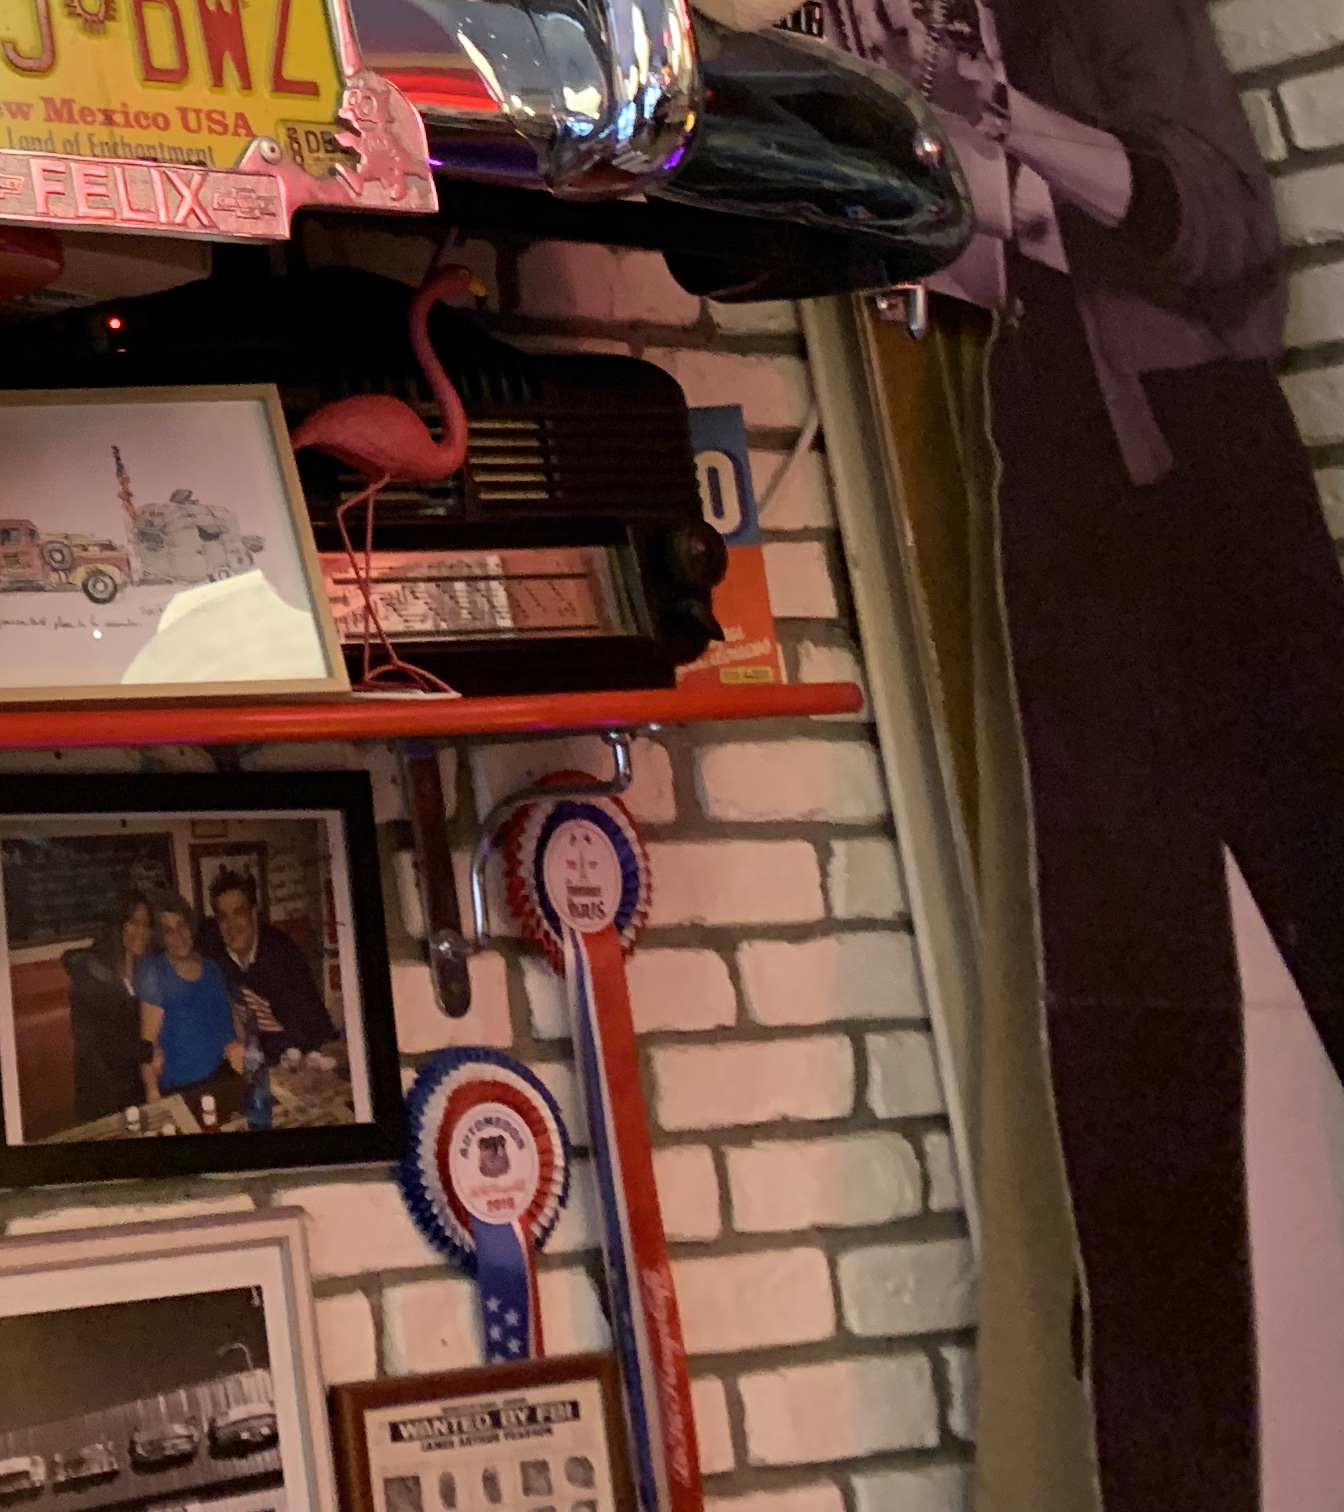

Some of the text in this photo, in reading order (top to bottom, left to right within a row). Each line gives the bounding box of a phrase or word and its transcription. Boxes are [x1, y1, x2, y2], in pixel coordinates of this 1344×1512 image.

[41, 96, 172, 133] Mexico
[176, 106, 258, 140] USA
[28, 157, 219, 231] FELIX
